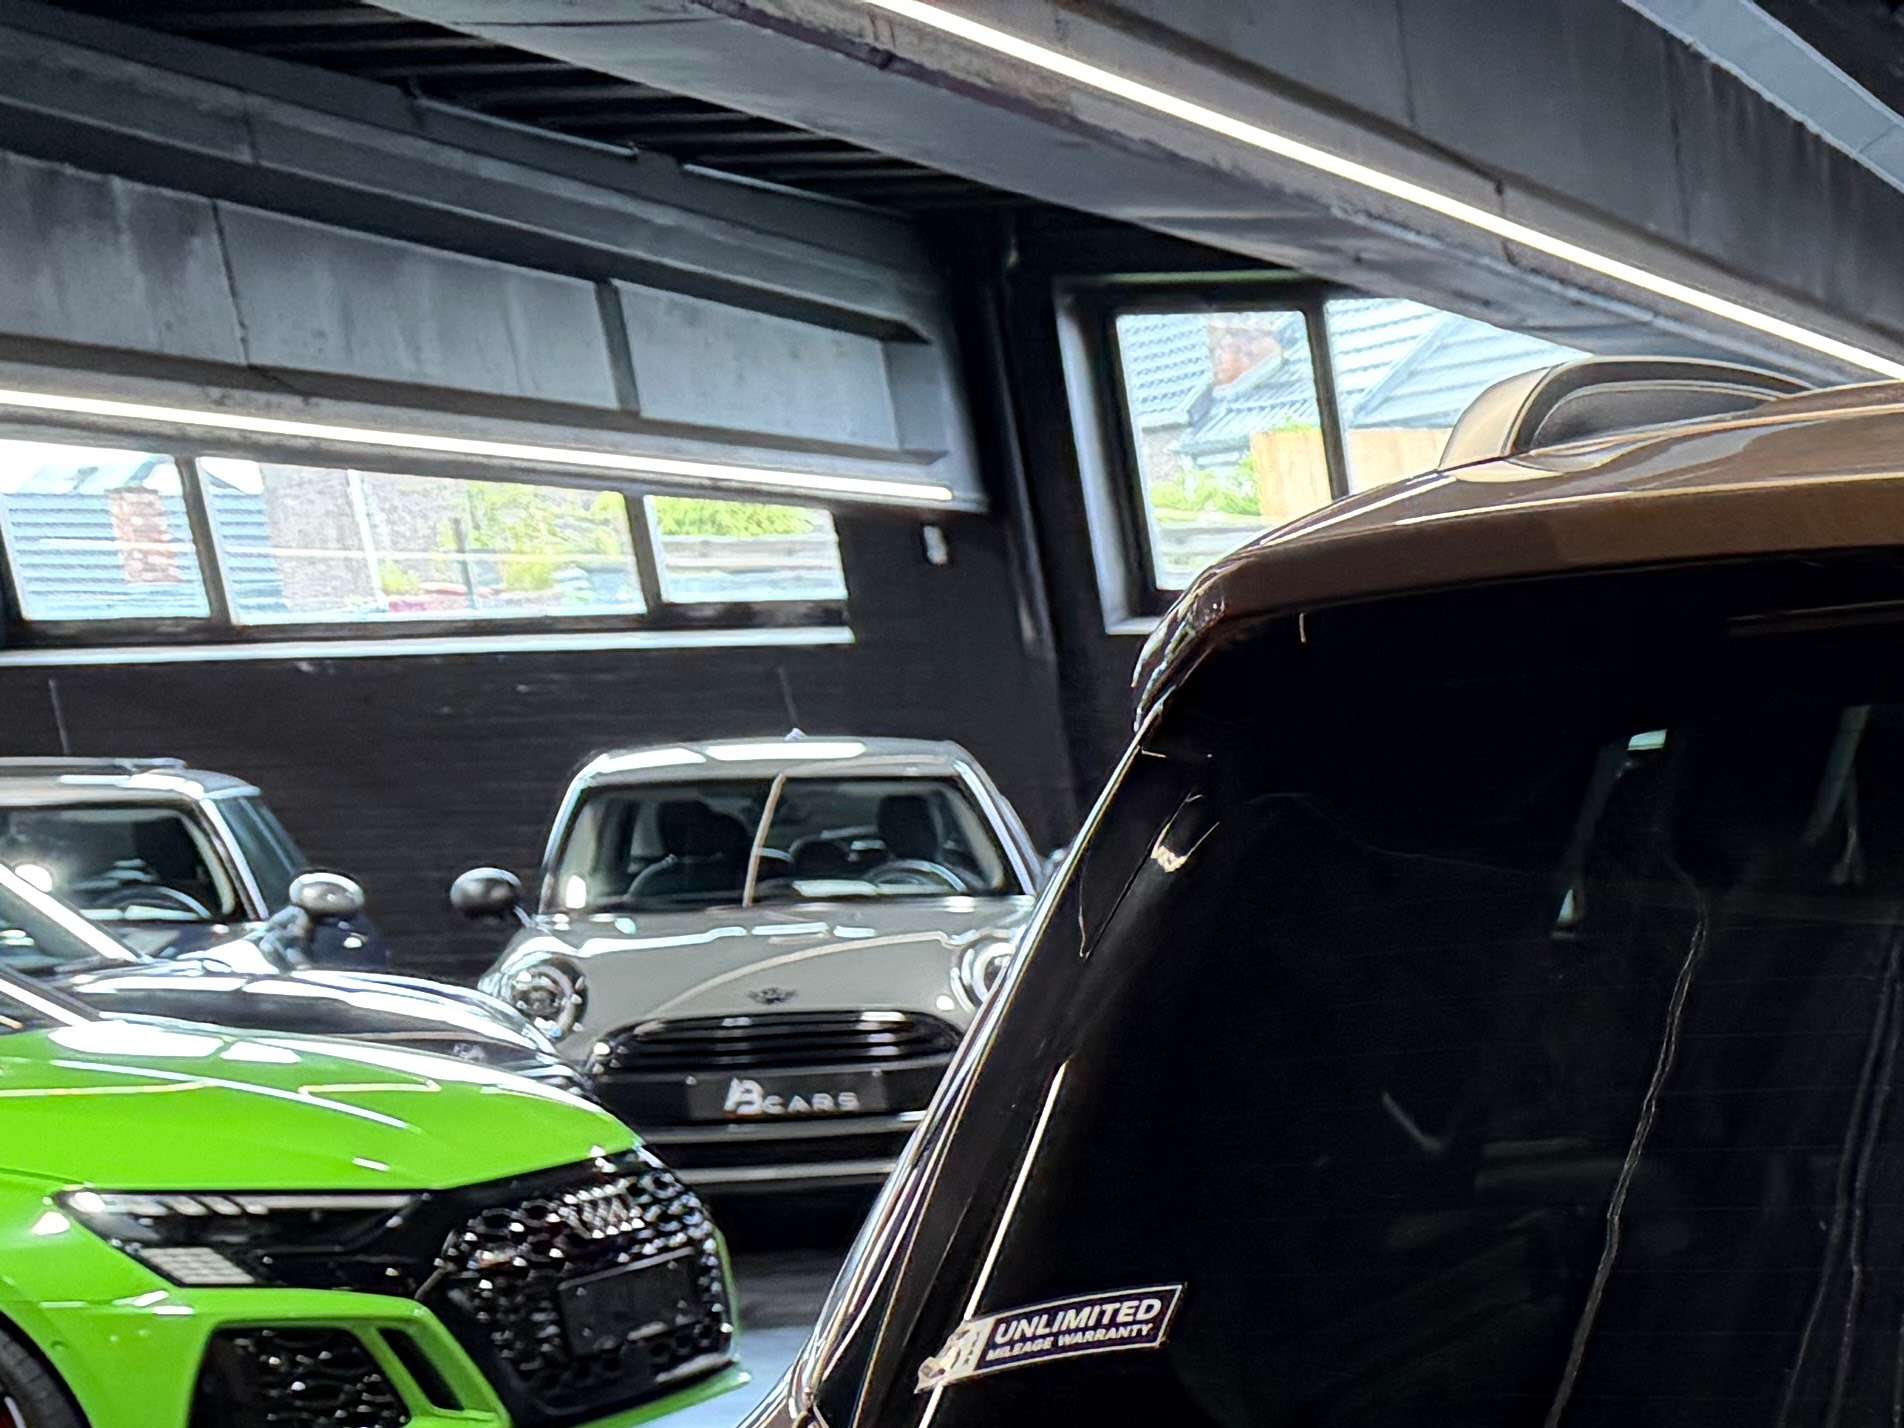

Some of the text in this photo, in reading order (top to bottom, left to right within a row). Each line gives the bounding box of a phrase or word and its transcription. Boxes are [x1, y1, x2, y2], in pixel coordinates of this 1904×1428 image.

[985, 1336, 1054, 1362] MILEAGE
[1057, 1322, 1155, 1347] WARRANTY
[994, 1298, 1162, 1345] UNLIMITED
